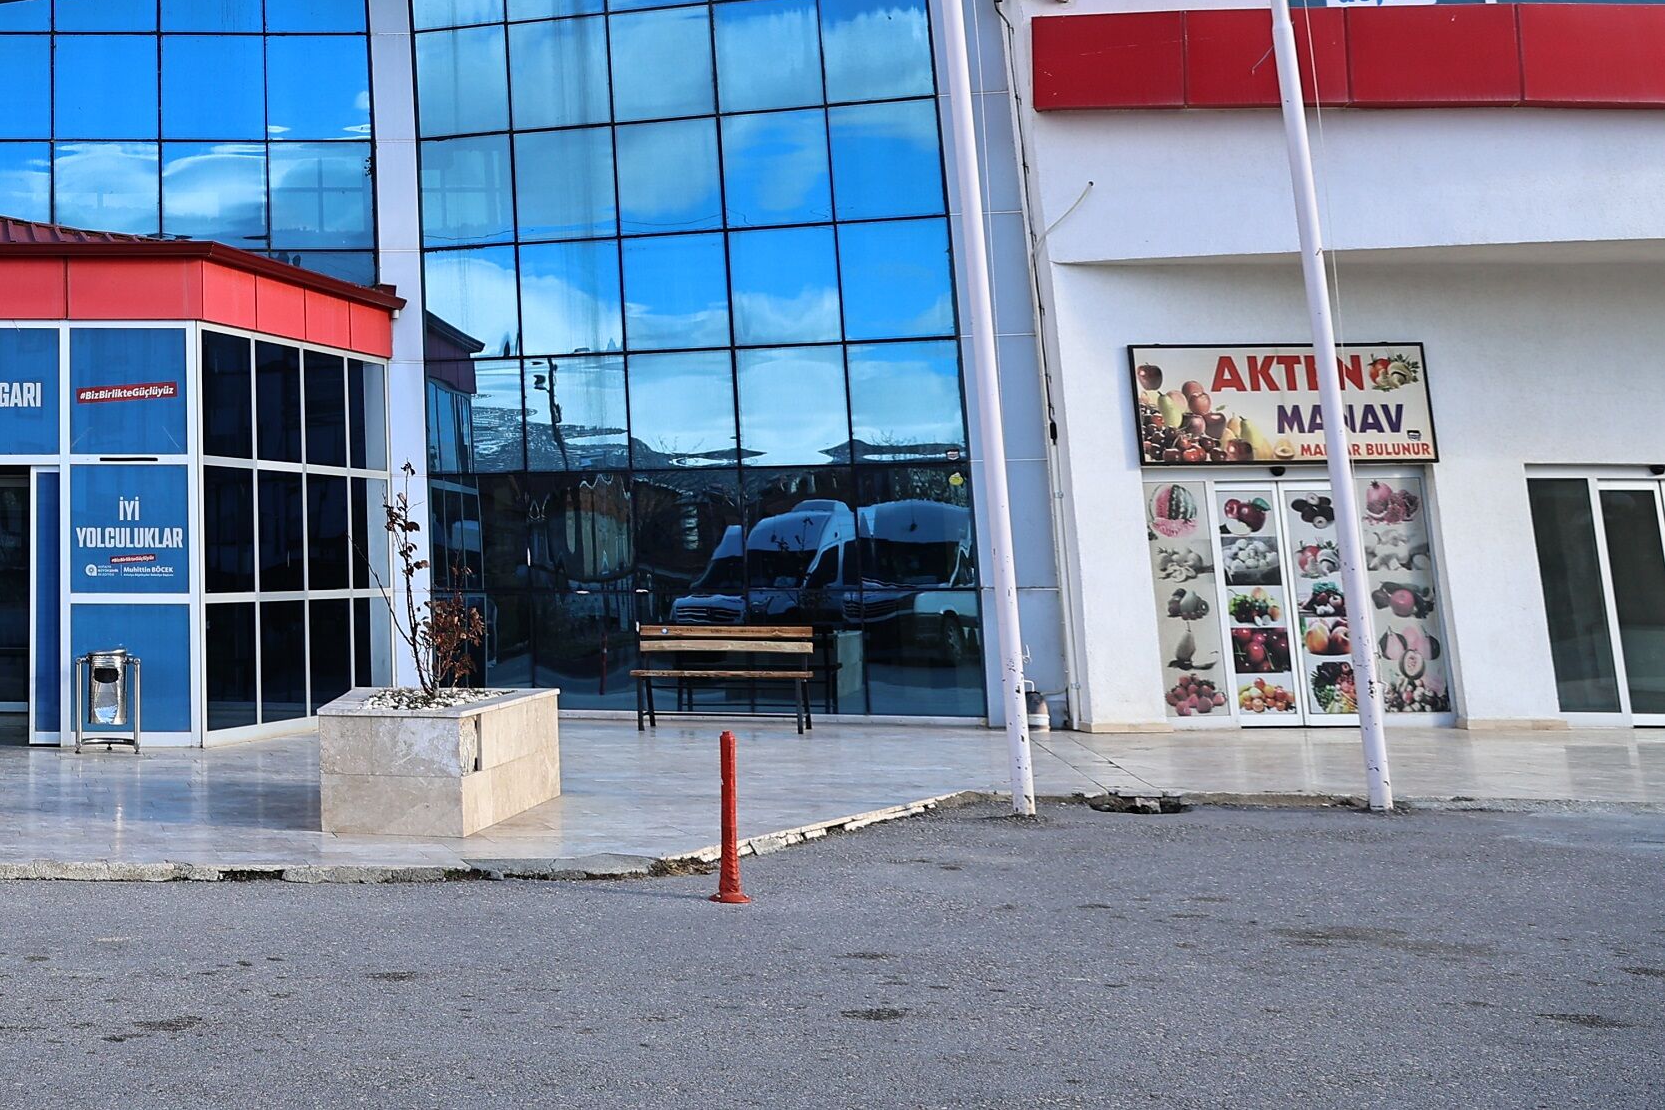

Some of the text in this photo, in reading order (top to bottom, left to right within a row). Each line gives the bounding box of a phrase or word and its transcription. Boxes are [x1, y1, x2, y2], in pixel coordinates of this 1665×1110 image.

[79, 385, 175, 401] #BizBirlikteGüçlüyüz
[1366, 442, 1432, 456] BULUNUR
[119, 496, 140, 521] İYİ
[75, 527, 183, 548] YOLCULUKLAR
[123, 565, 174, 574] Muhittin BÖCEK
